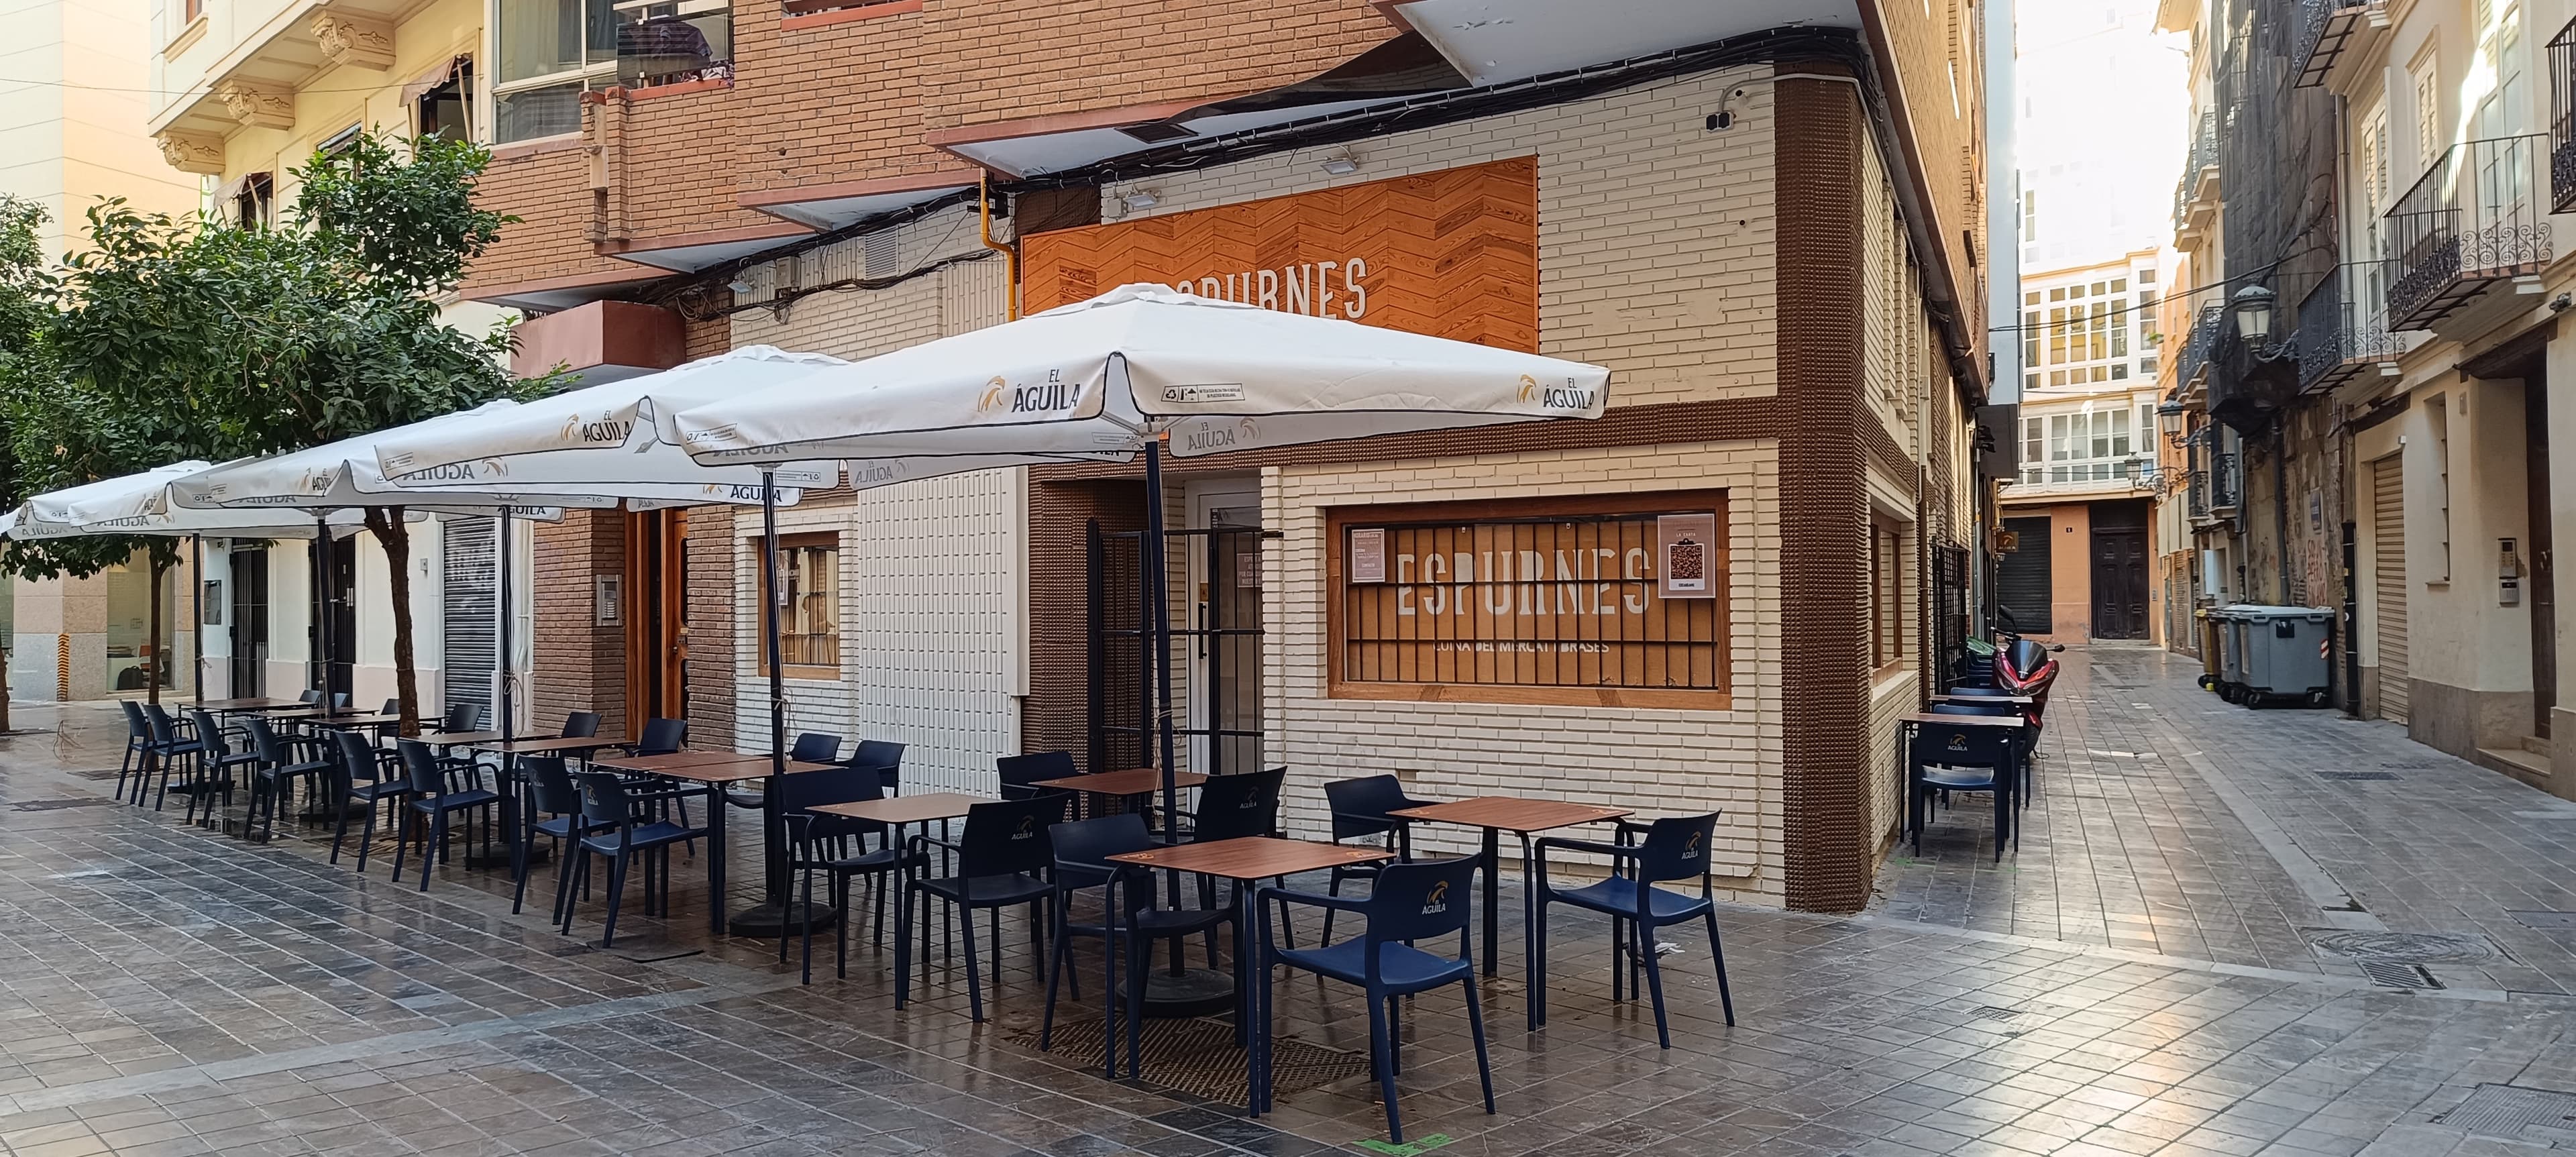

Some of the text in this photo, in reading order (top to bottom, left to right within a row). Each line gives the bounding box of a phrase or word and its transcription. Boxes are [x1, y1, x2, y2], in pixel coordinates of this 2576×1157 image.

[1049, 369, 1060, 382] EL
[1568, 377, 1577, 388] EL
[1011, 384, 1081, 413] ÁGUILA
[1543, 384, 1595, 410] ÁGUILA
[604, 410, 612, 421] EL
[582, 421, 631, 442] ÁGUILA
[1397, 547, 1651, 616] ESPURNES
